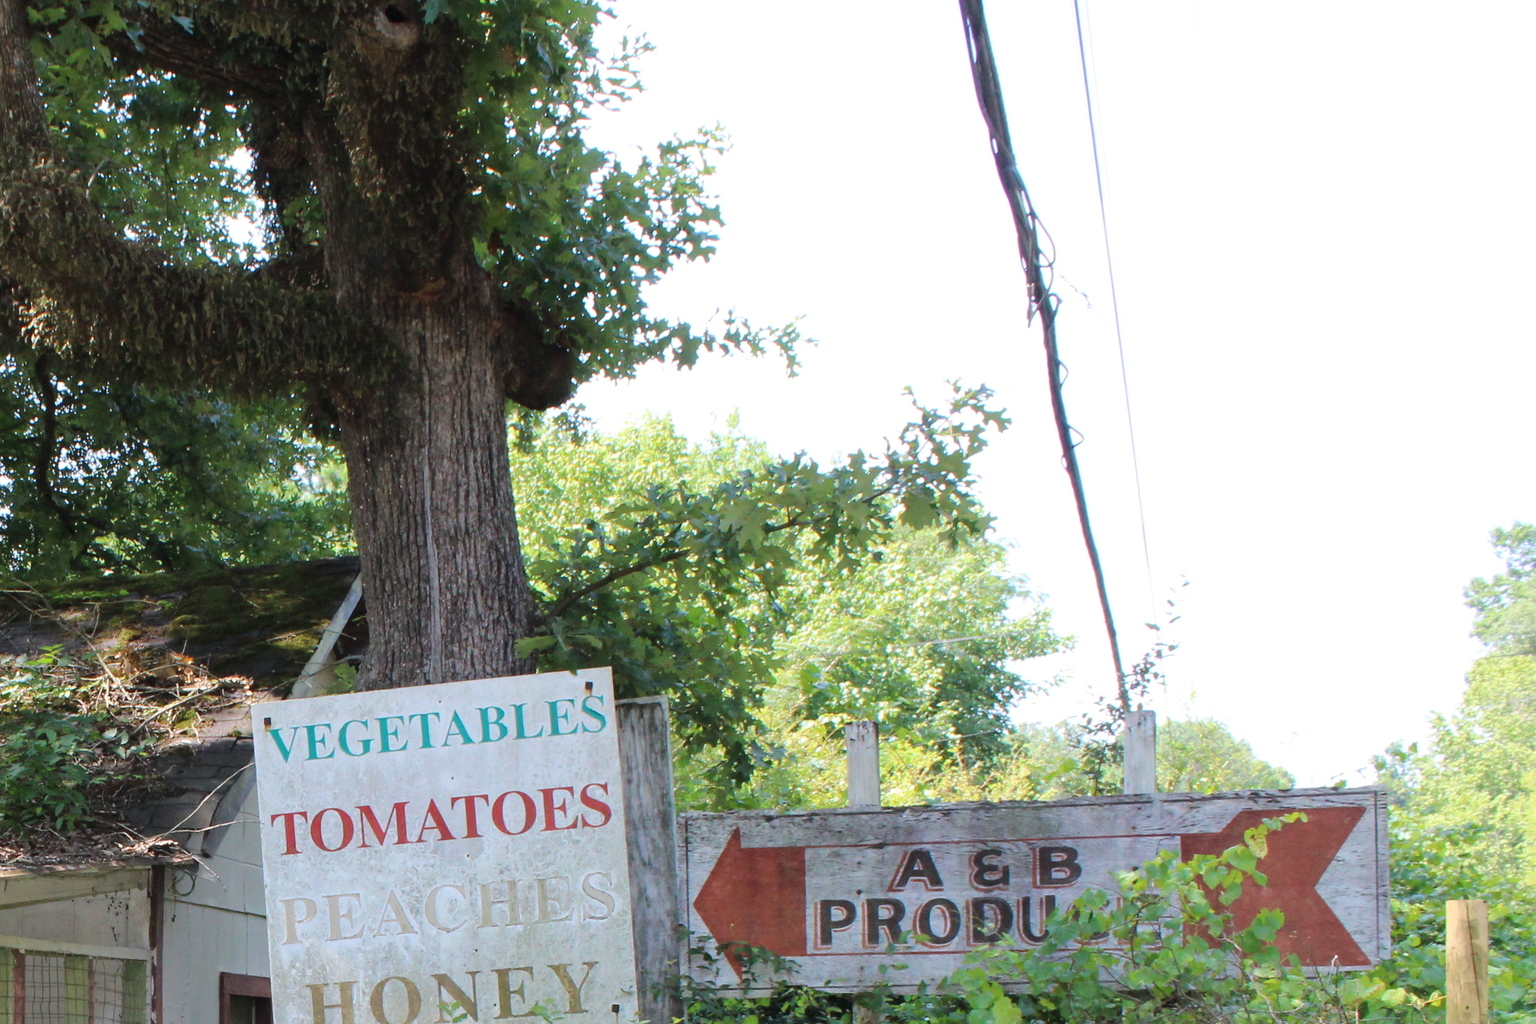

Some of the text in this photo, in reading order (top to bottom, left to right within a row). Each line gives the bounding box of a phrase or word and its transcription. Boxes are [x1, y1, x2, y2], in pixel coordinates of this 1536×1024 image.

[267, 694, 608, 764] VEGETABLES
[270, 782, 613, 856] TOMATOES
[887, 845, 1082, 893] A & B
[278, 871, 616, 946] PEACHES
[814, 894, 1161, 950] PRODU
